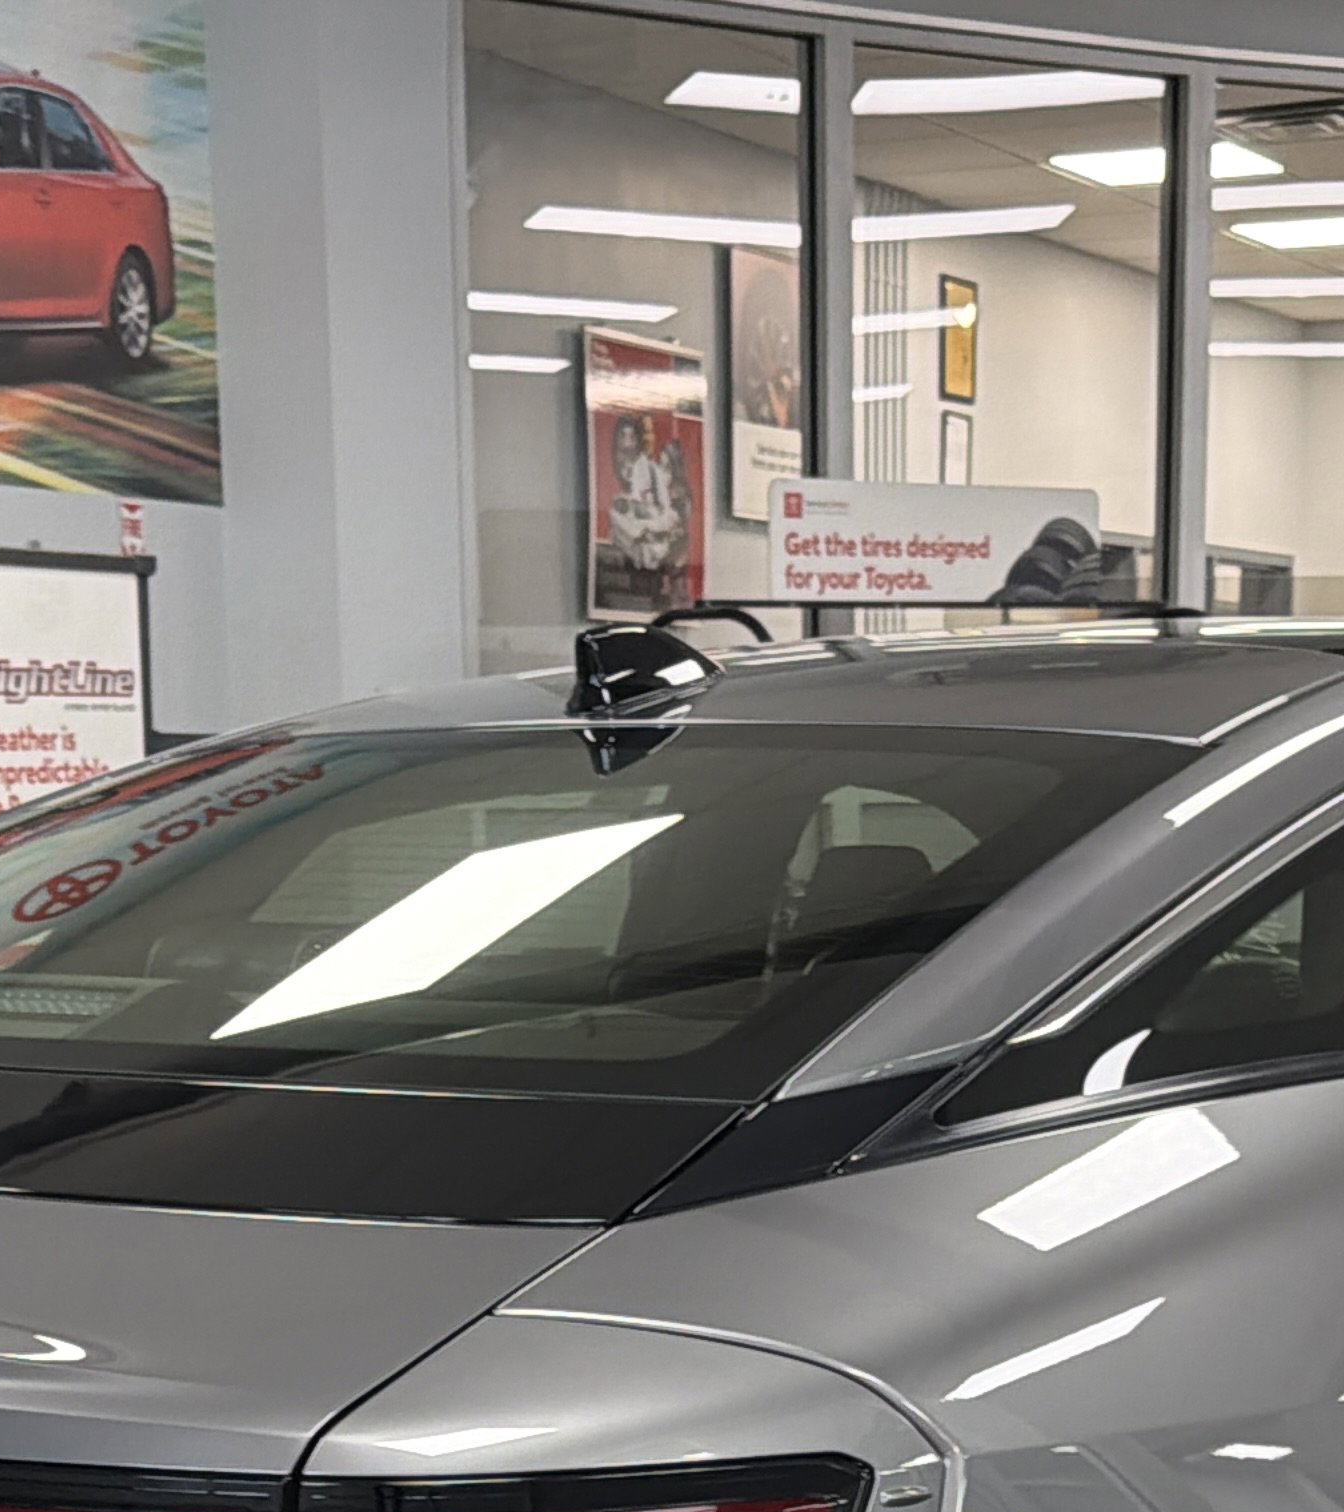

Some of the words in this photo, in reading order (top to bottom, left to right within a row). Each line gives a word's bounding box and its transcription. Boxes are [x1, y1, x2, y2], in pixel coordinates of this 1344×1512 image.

[784, 532, 821, 557] Get
[825, 534, 857, 558] the
[861, 535, 902, 559] tires
[906, 536, 990, 564] designed
[785, 565, 813, 590] for
[816, 571, 861, 596] your
[864, 567, 932, 596] Toyota.
[61, 724, 77, 752] is
